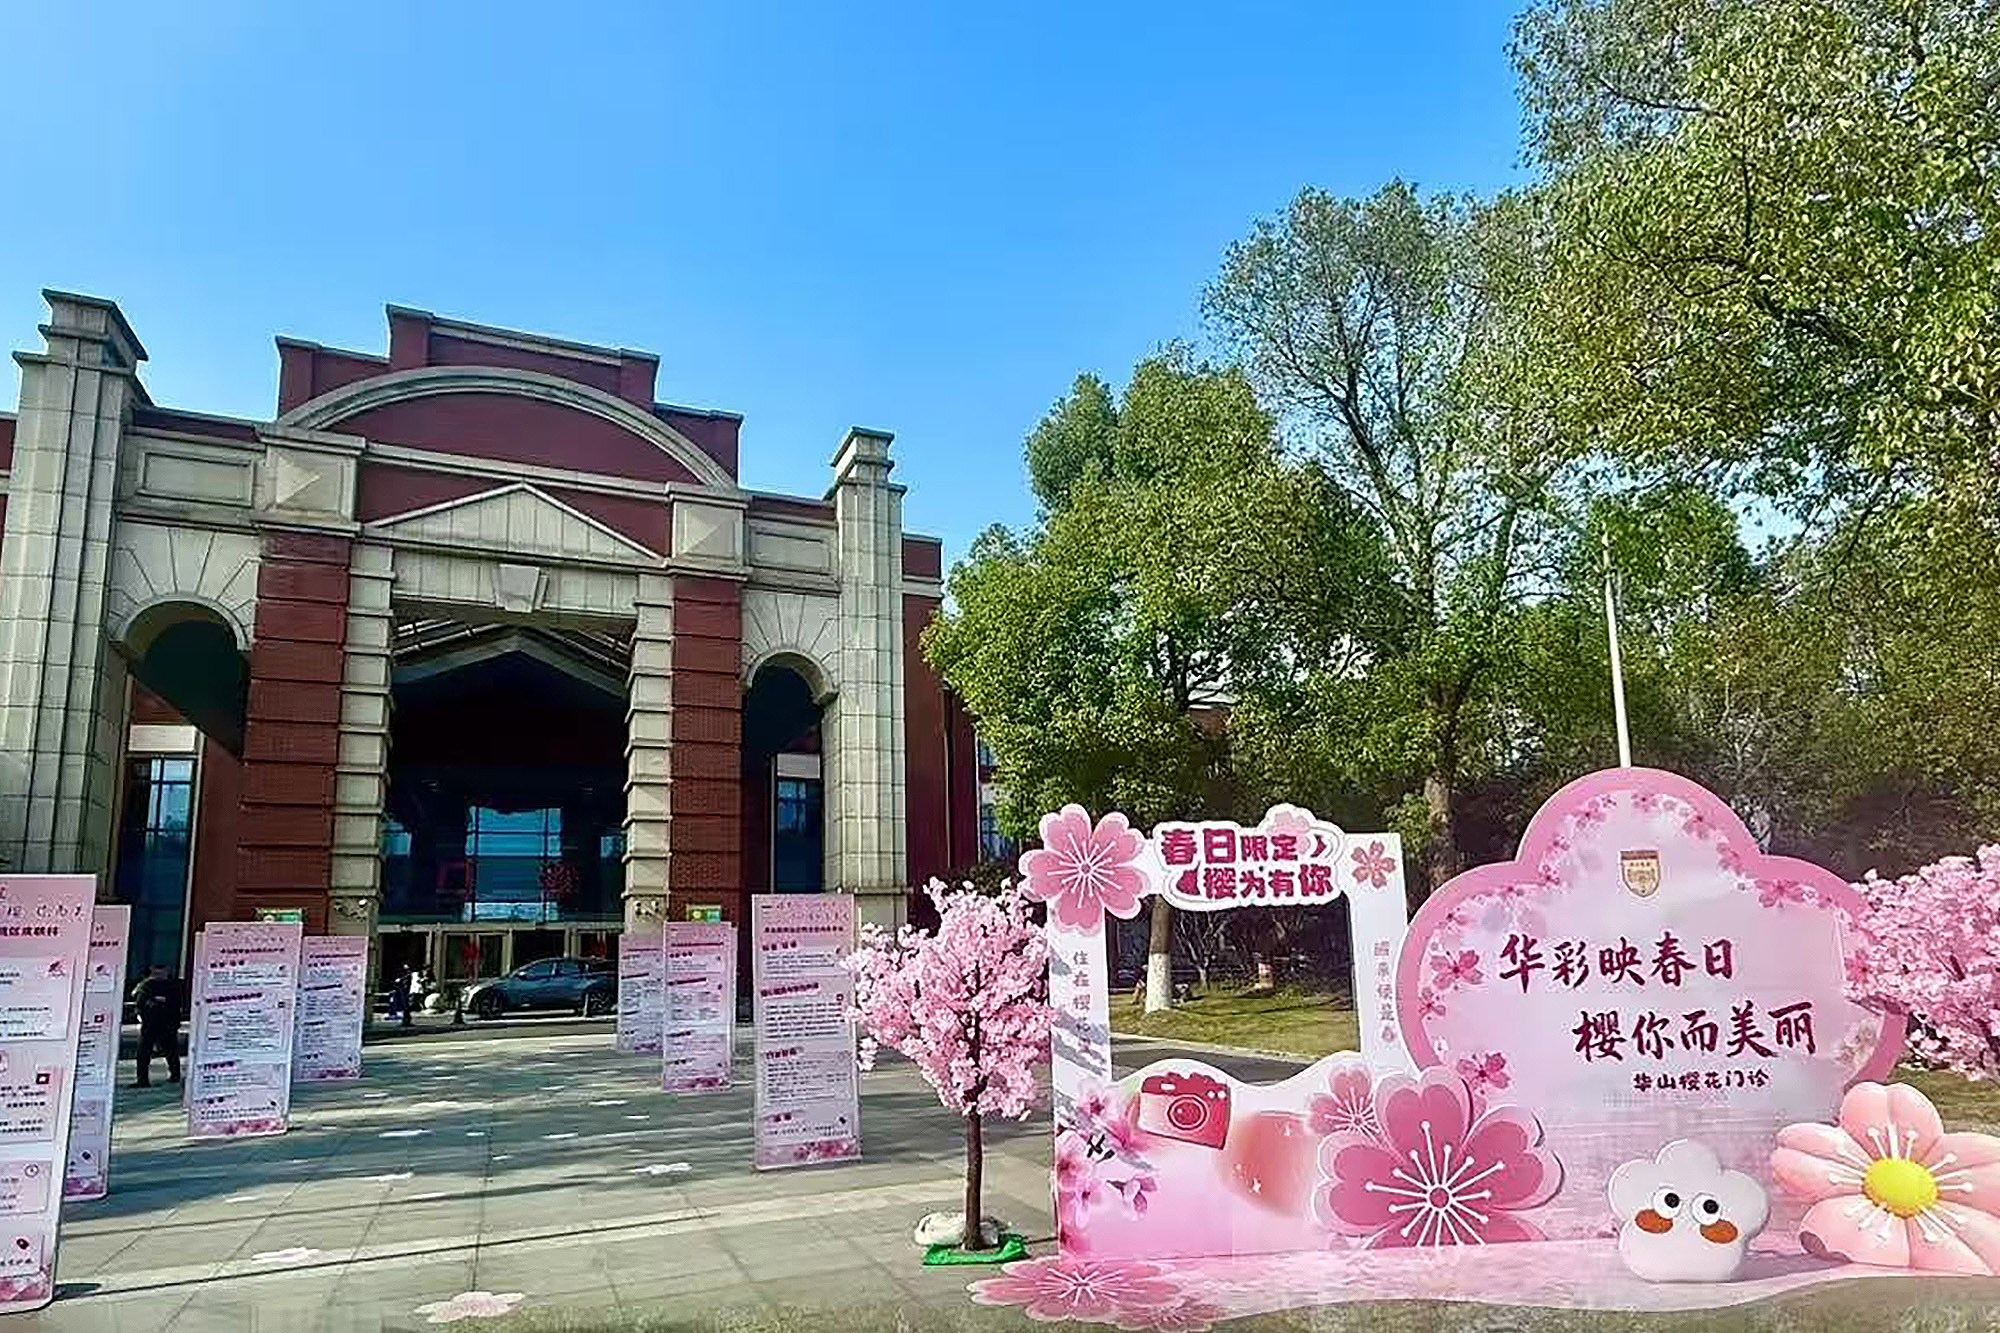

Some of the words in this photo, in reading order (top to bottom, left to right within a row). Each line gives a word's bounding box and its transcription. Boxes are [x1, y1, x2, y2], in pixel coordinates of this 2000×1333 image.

[1161, 829, 1299, 865] 春日限定
[1203, 864, 1334, 899] 樱为有你
[1500, 931, 1733, 993] 华彩映春日
[1572, 1000, 1817, 1061] 樱你而美丽
[1633, 1069, 1769, 1092] 华山樱花门诊
